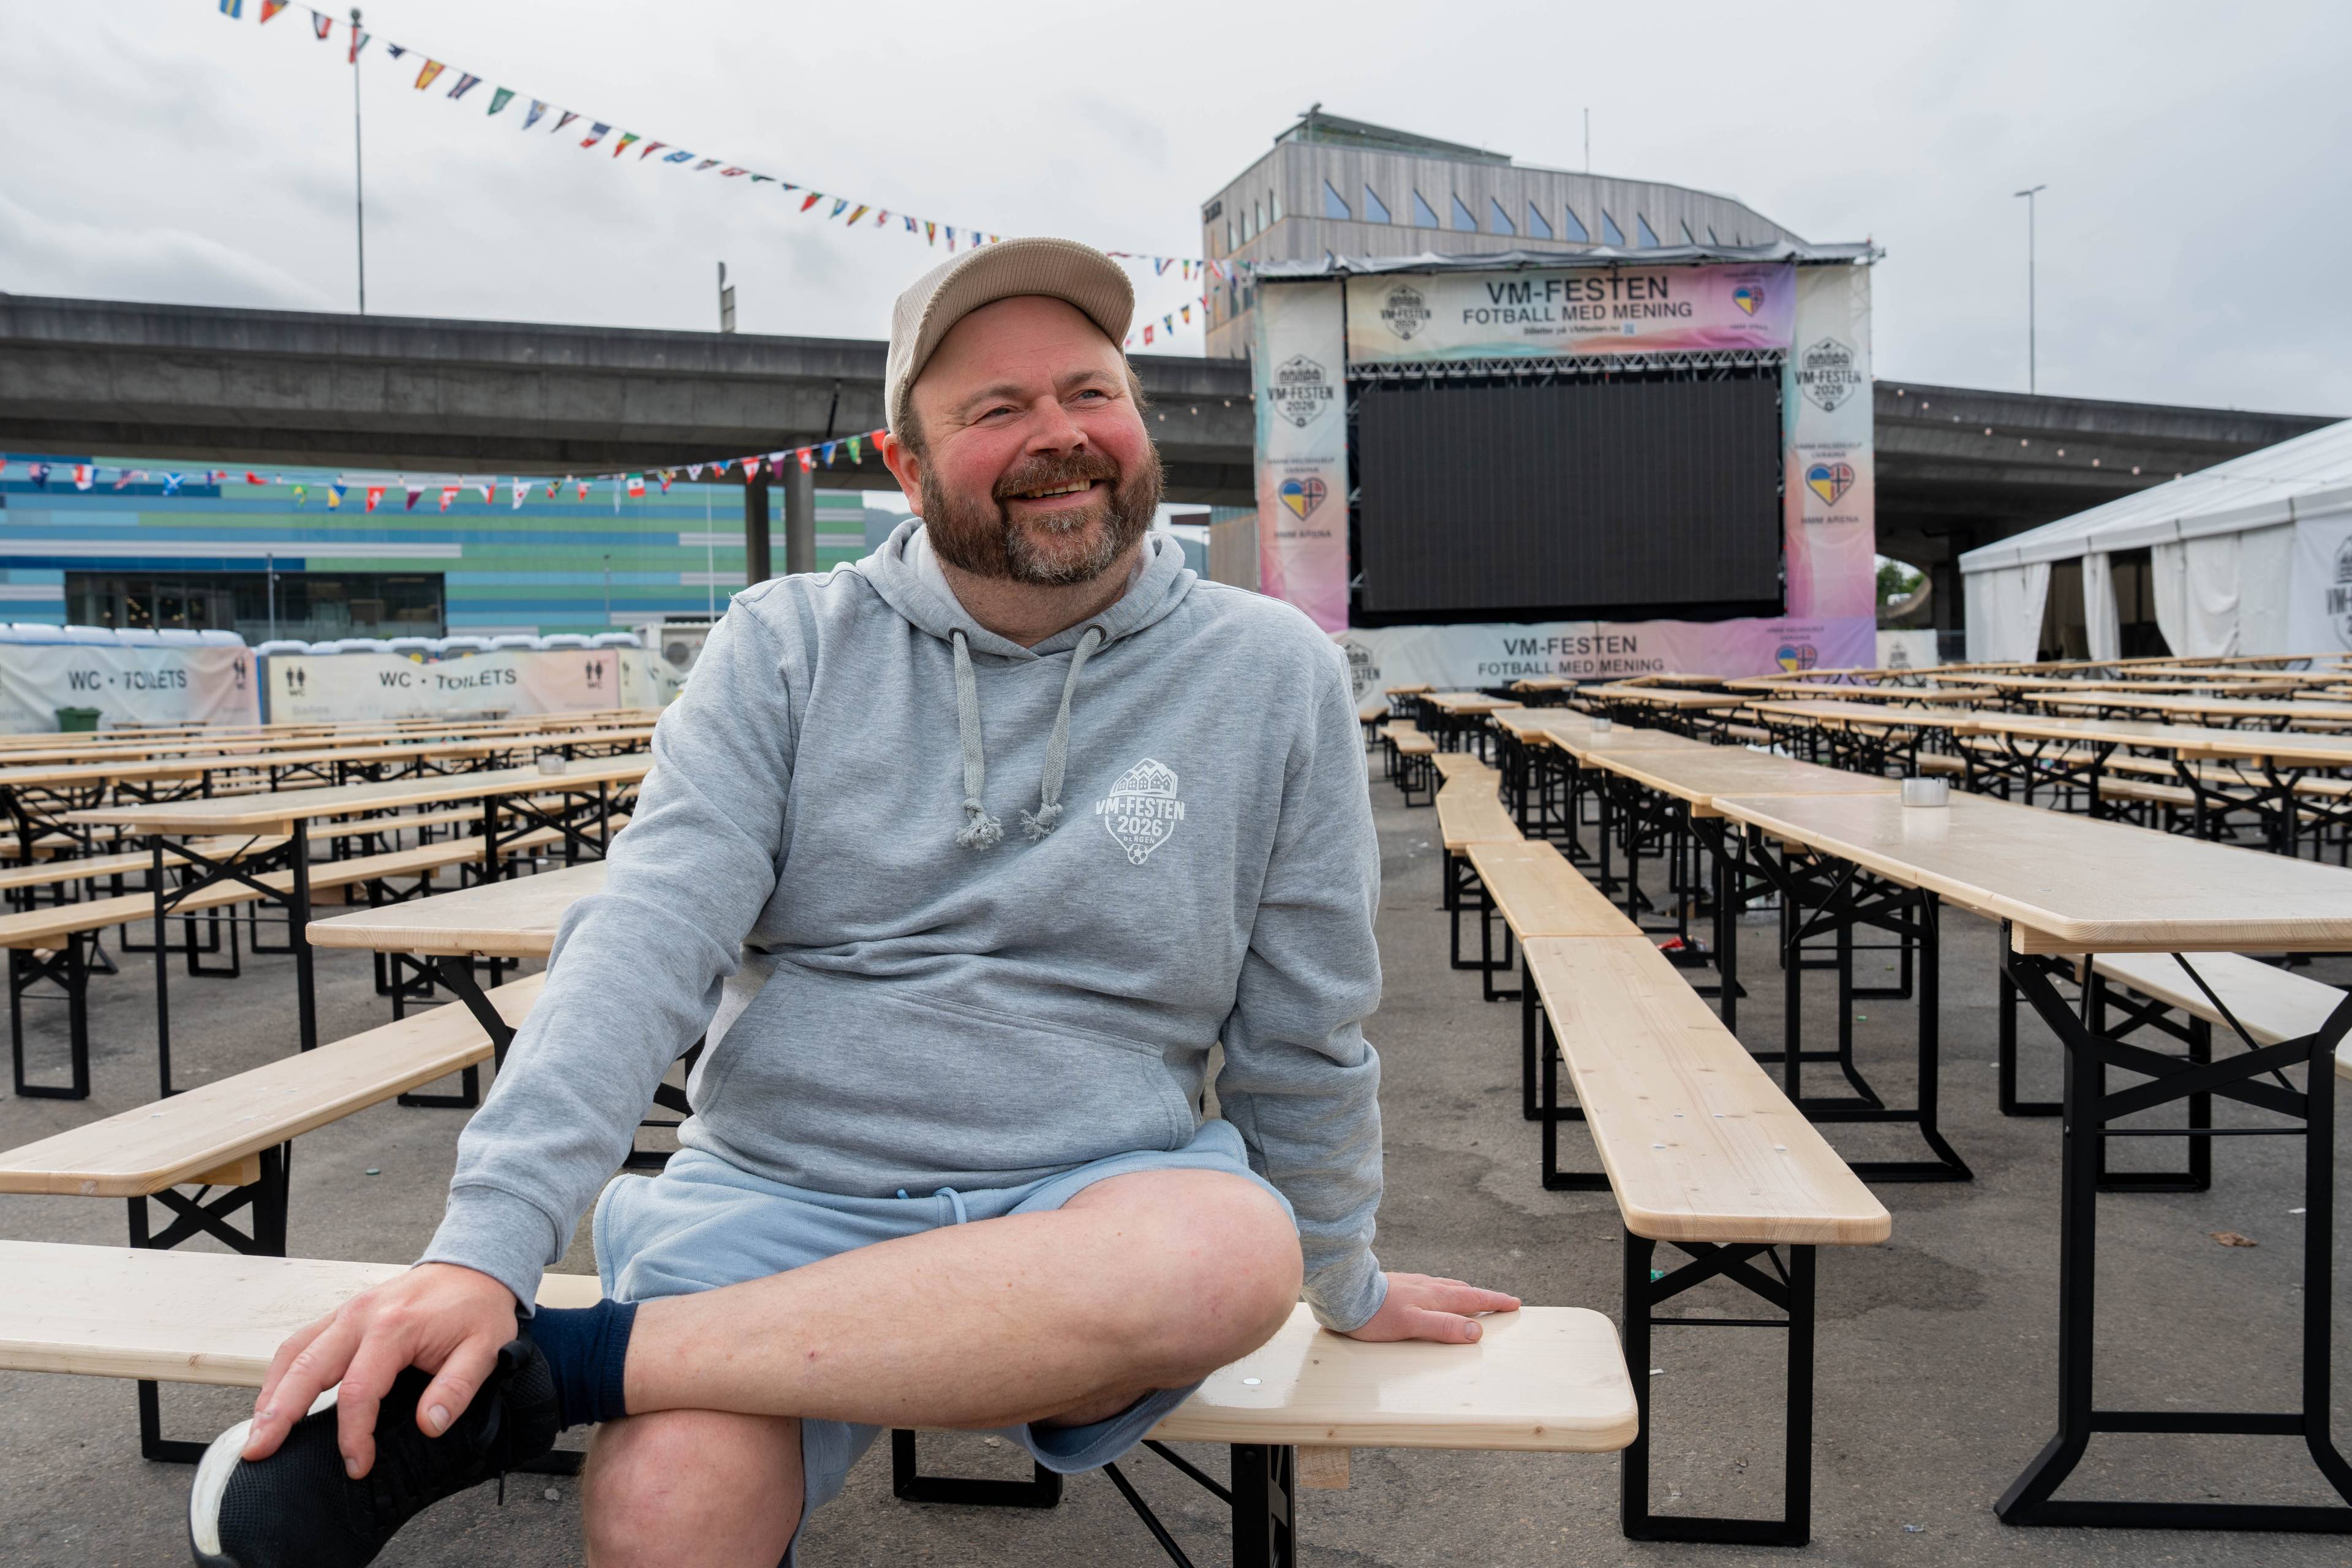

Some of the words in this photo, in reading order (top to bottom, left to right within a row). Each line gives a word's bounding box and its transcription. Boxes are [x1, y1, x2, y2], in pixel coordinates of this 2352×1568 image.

[1487, 276, 1668, 304] VM-FESTEN
[1381, 308, 1431, 320] VM-FESTEN
[1463, 307, 1555, 324] FOTBALL
[1562, 305, 1605, 322] MED
[1613, 302, 1692, 319] MENING
[1795, 371, 1861, 385] VM-FESTEN
[1267, 385, 1333, 401] VM-FESTEN
[1503, 635, 1637, 655] VM-FESTEN
[1478, 662, 1555, 675] FOTBALL
[1559, 660, 1594, 673] MED
[1600, 658, 1664, 673] MENING
[68, 670, 102, 690] WC
[380, 671, 411, 687] WC
[436, 668, 517, 690] TOILETS
[288, 688, 306, 696] WC
[1096, 796, 1185, 820] VM-FESTEN
[1117, 815, 1163, 837] 2026
[1123, 835, 1155, 844] BERGEN
